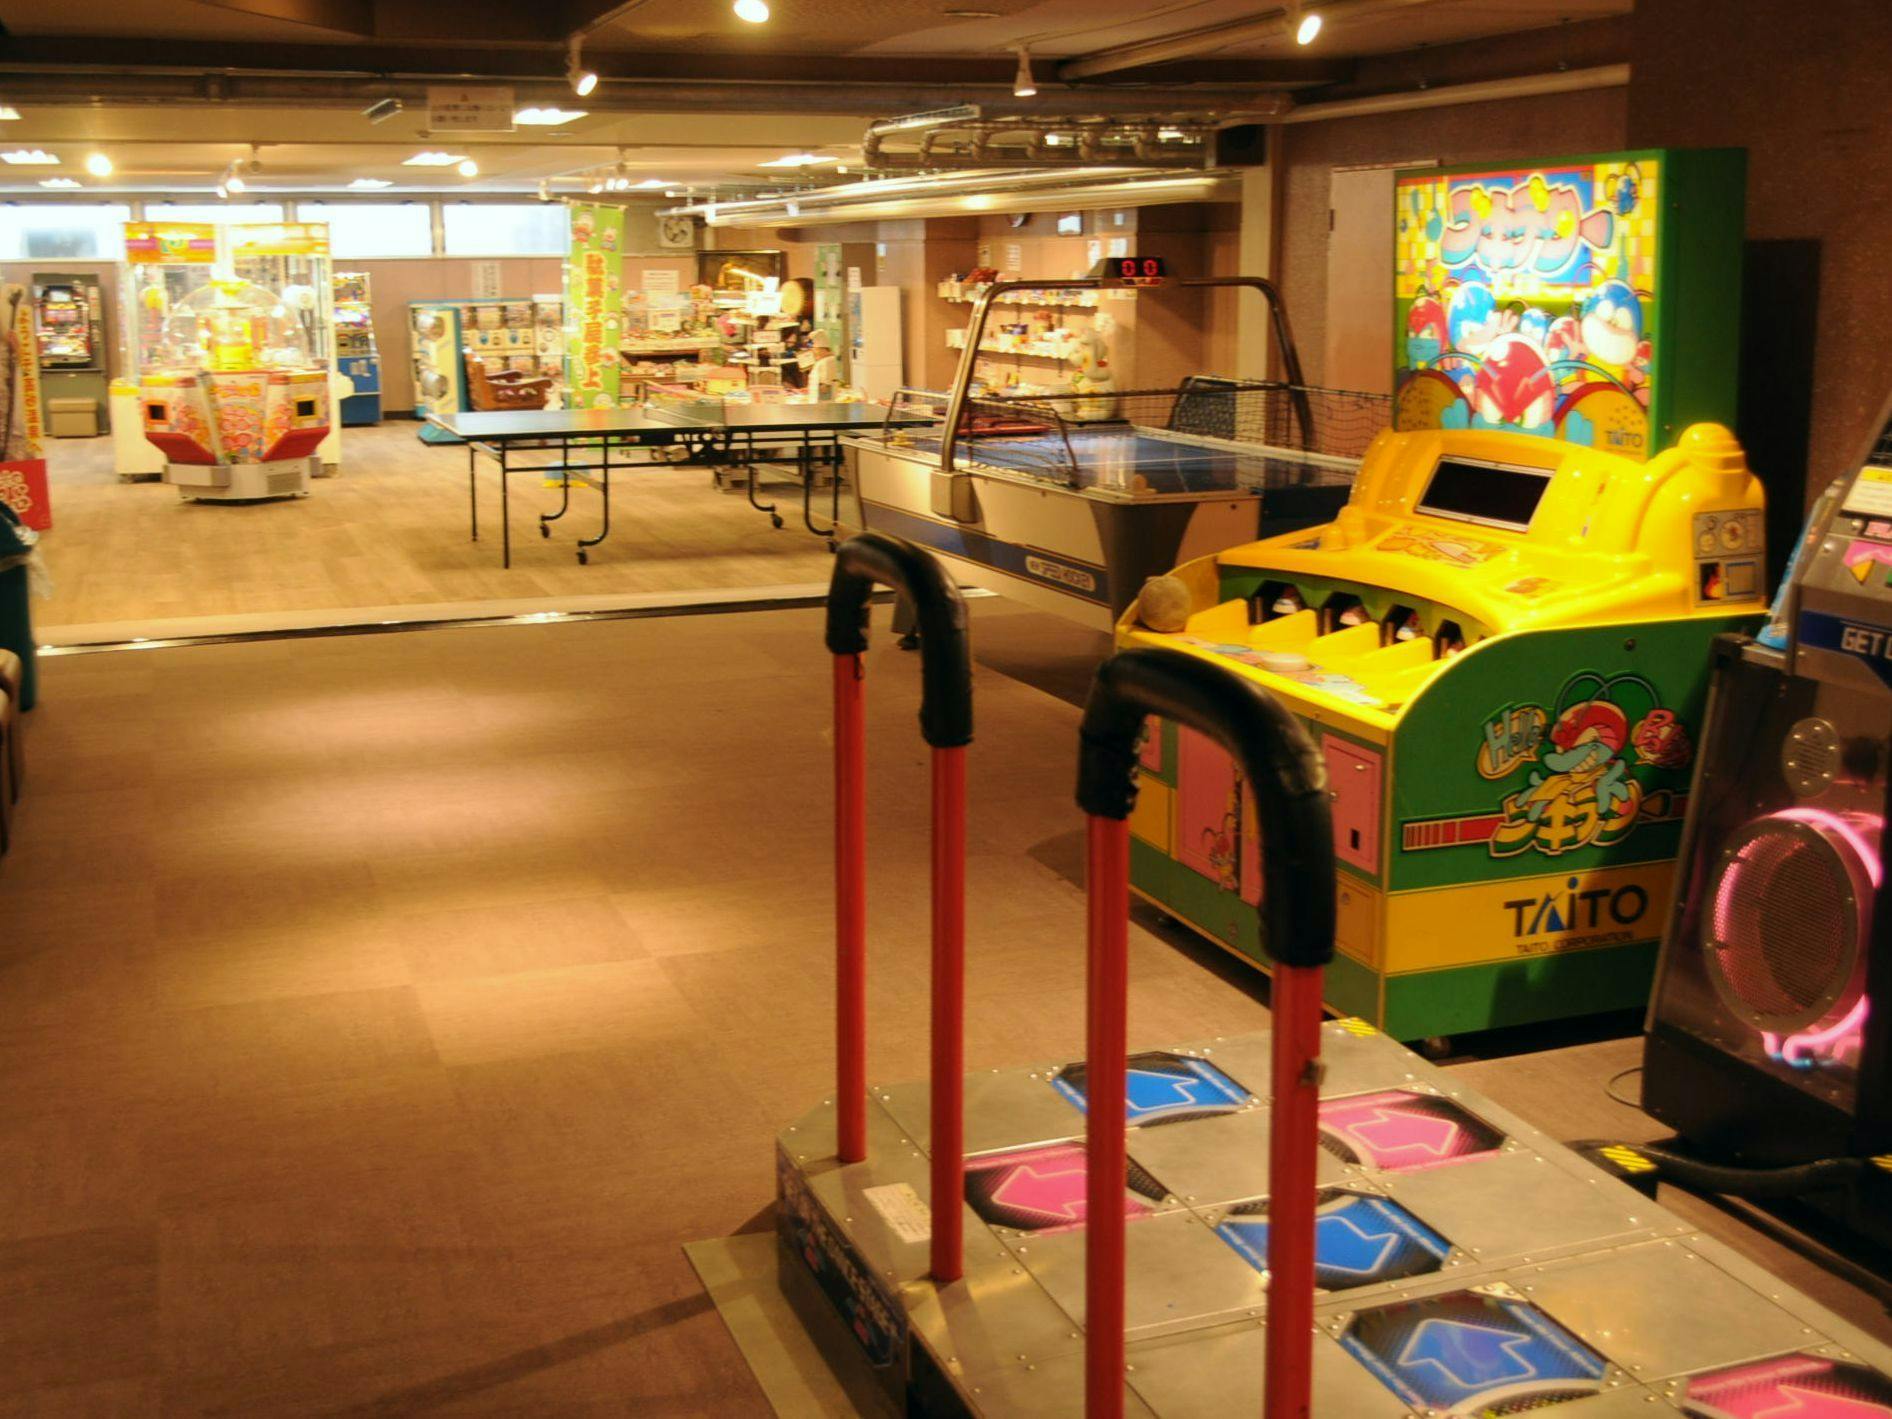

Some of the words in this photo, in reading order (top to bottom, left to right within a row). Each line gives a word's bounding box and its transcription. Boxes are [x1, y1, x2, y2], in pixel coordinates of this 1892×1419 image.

[1121, 259, 1136, 276] 0
[1143, 259, 1159, 276] 0
[1840, 626, 1885, 656] GET
